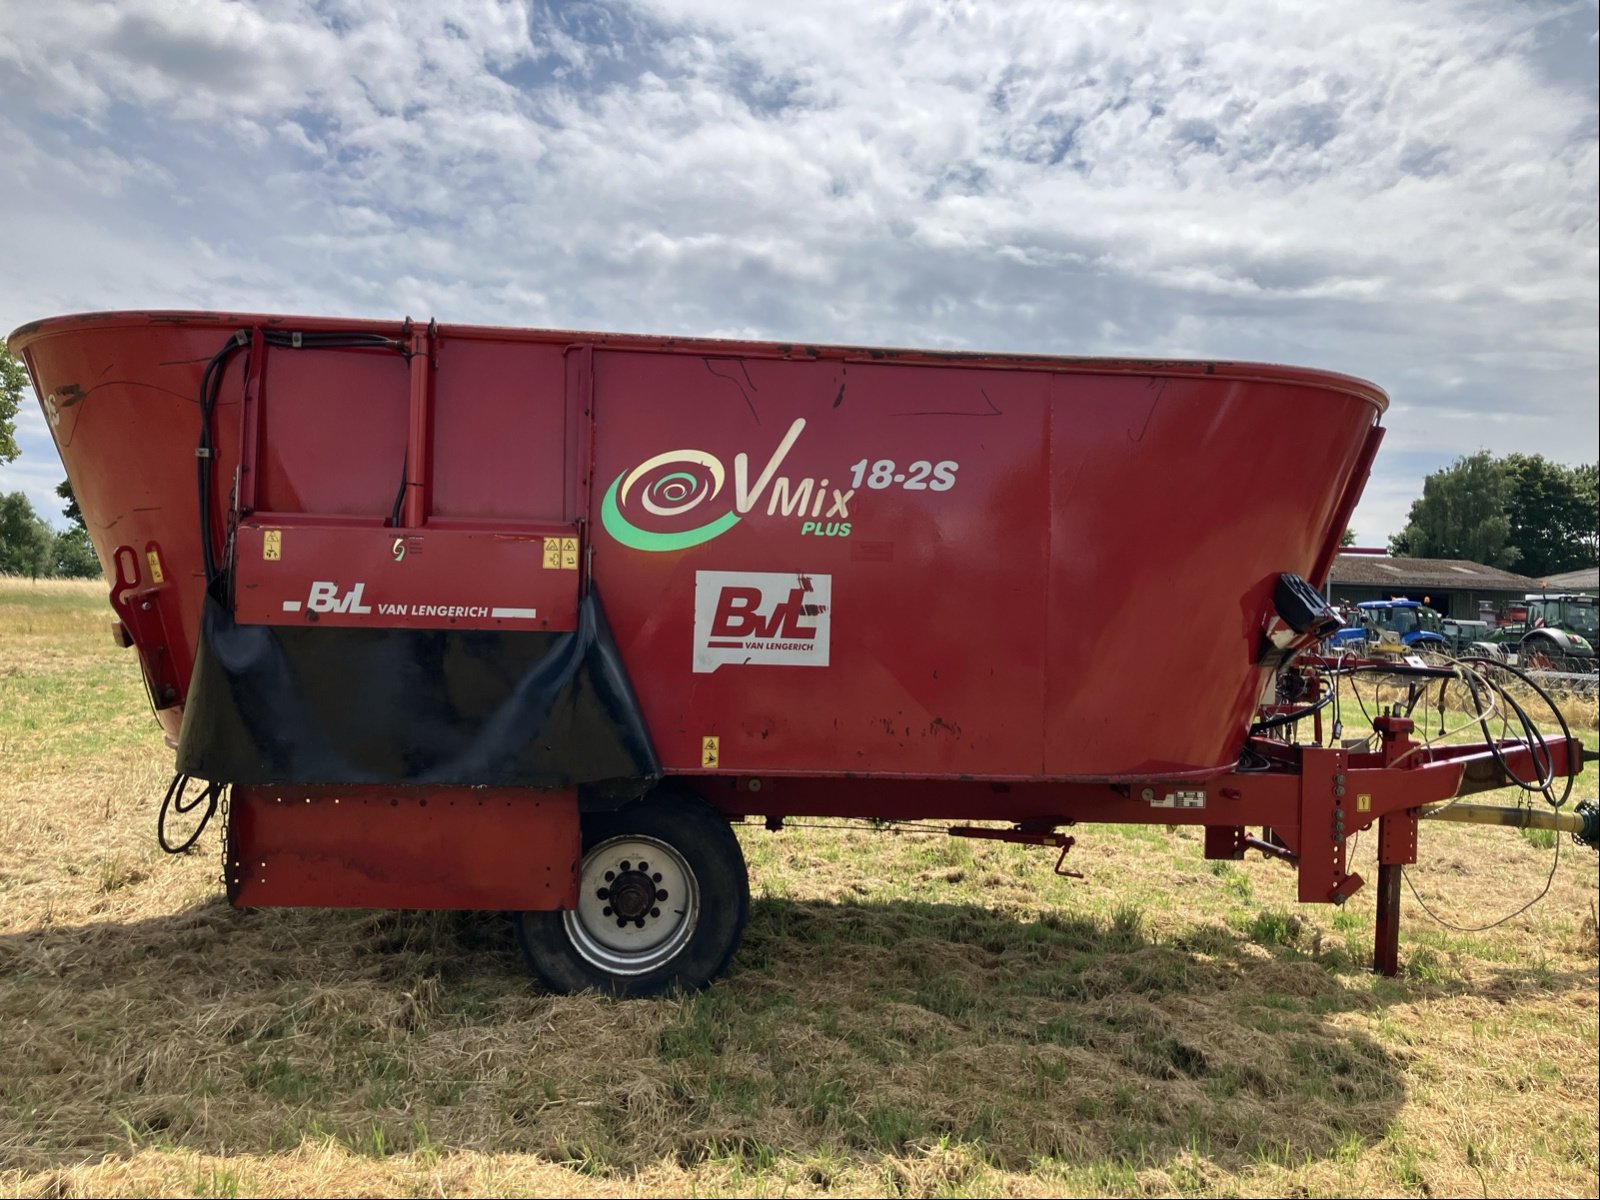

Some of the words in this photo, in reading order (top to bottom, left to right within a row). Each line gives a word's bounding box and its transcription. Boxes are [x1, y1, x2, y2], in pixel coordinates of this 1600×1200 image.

[850, 458, 959, 491] 18-2S
[801, 521, 852, 537] PLUS
[378, 604, 408, 616] VAN
[411, 605, 489, 618] LENGERICH
[745, 642, 763, 650] VAN
[766, 642, 814, 651] LENGERICH
